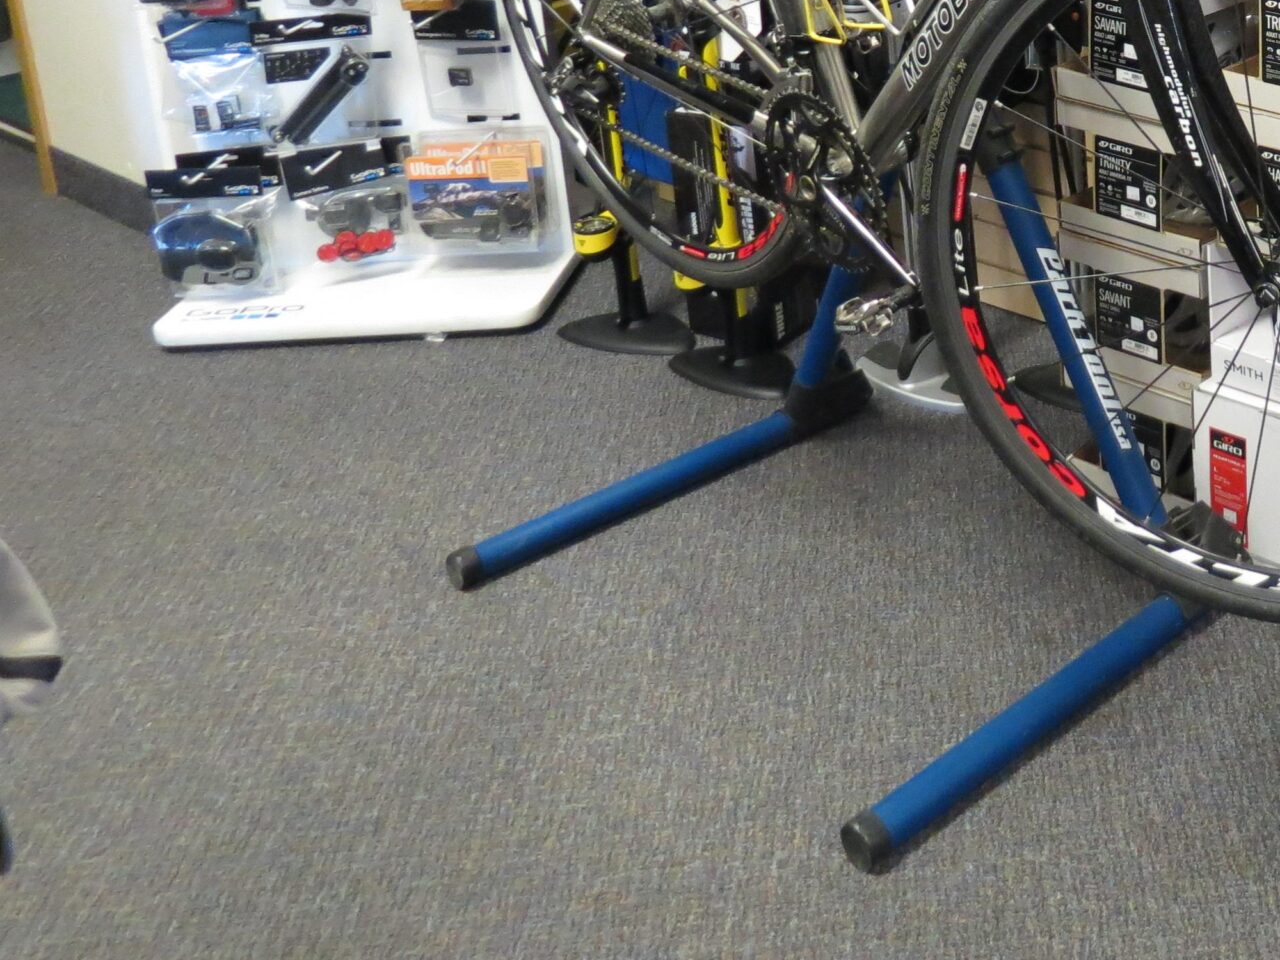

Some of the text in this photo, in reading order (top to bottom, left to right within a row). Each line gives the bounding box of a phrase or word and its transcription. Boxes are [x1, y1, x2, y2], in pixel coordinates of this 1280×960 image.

[1153, 22, 1194, 120] highmodulus
[409, 160, 474, 176] UltraPod
[953, 227, 971, 297] Lite
[1098, 287, 1132, 309] SAVANT
[185, 304, 305, 317] GoPro
[1223, 359, 1264, 382] SMITH
[1213, 440, 1243, 456] GIRO
